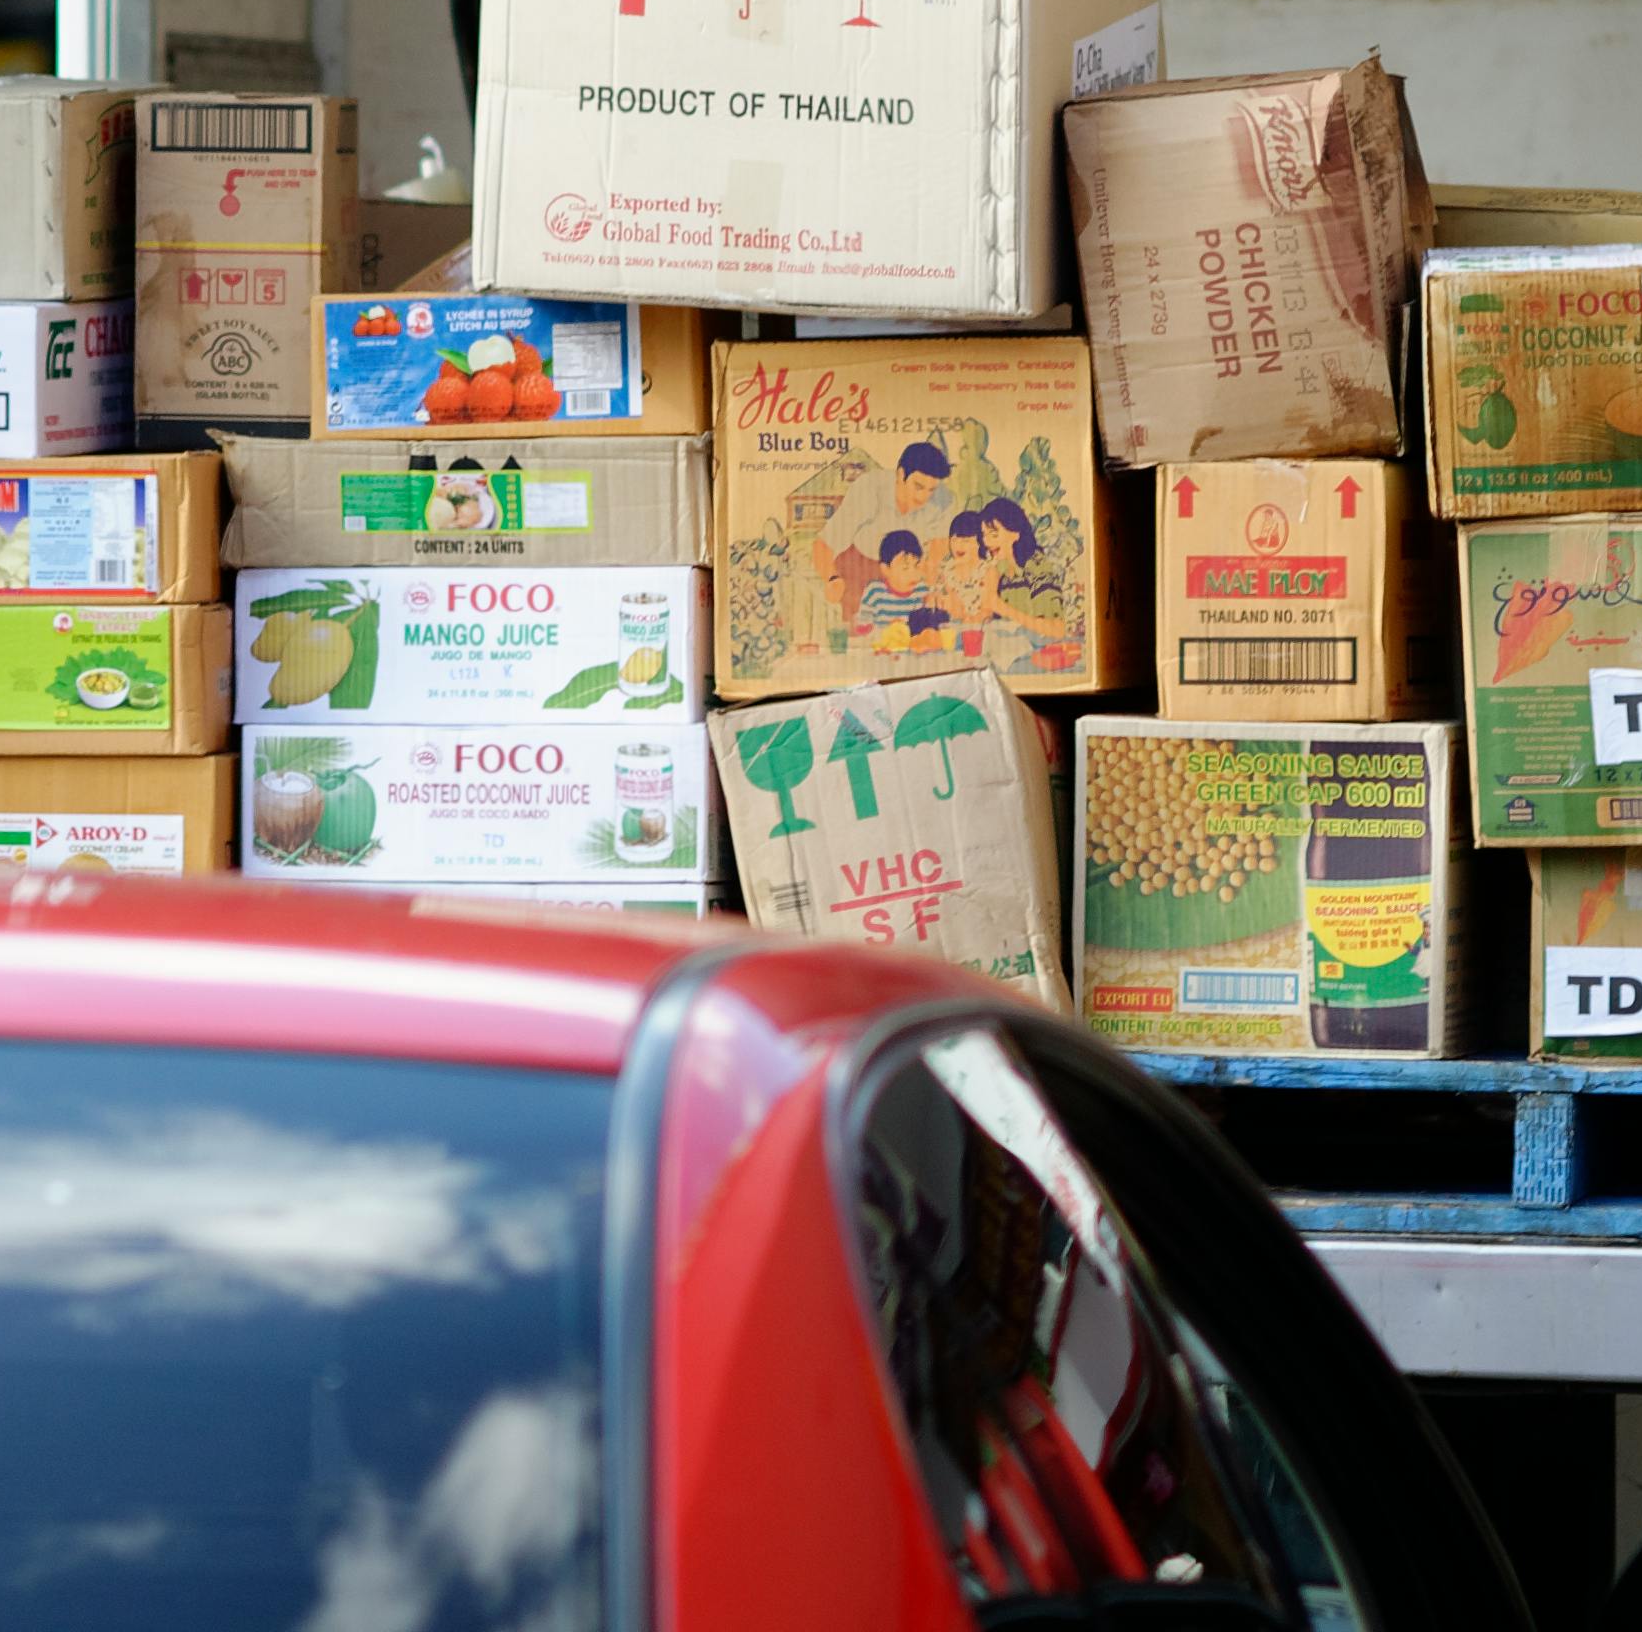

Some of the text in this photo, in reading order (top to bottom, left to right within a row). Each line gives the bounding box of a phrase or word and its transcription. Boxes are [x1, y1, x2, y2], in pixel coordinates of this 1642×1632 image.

[578, 85, 914, 125] PRODUCT OF THAILAND
[1258, 96, 1316, 205] Knorr
[609, 193, 722, 216] Exported by:
[1091, 168, 1111, 242] Unilever
[603, 220, 661, 244] Global
[668, 223, 712, 246] Food
[720, 226, 791, 253] Trading
[1143, 246, 1159, 268] 24
[263, 284, 275, 301] 5
[1195, 228, 1241, 379] POWDER
[1234, 222, 1283, 374] CHICKEN
[1523, 324, 1629, 352] COCONUT
[218, 355, 245, 368] ABC
[1574, 355, 1595, 367] DE
[731, 361, 871, 430] Hale's
[758, 432, 850, 455] Blue Boy
[414, 539, 524, 555] CONTENT 24 UNITS
[1205, 570, 1331, 596] MAE PLOY
[447, 583, 555, 613] FOCO
[1199, 610, 1334, 624] THAILAND NO. 3071
[404, 623, 559, 646] MANGO JUICE
[430, 651, 532, 661] JUGO DE MANGO
[454, 744, 564, 774] FOCO
[1187, 753, 1424, 779] SEASONING SAUCE
[1594, 768, 1617, 782] 12
[387, 784, 590, 805] ROASTED COCONUT JUICE
[1196, 782, 1426, 808] GREEN CAP 600 ml
[65, 826, 147, 841] AROY-D
[1206, 817, 1426, 838] NATURALLY FERMENTED
[840, 848, 945, 897] VHC
[862, 897, 941, 947] S F
[1095, 993, 1170, 1007] EXPORT EU
[1091, 1020, 1153, 1033] CONTENT
